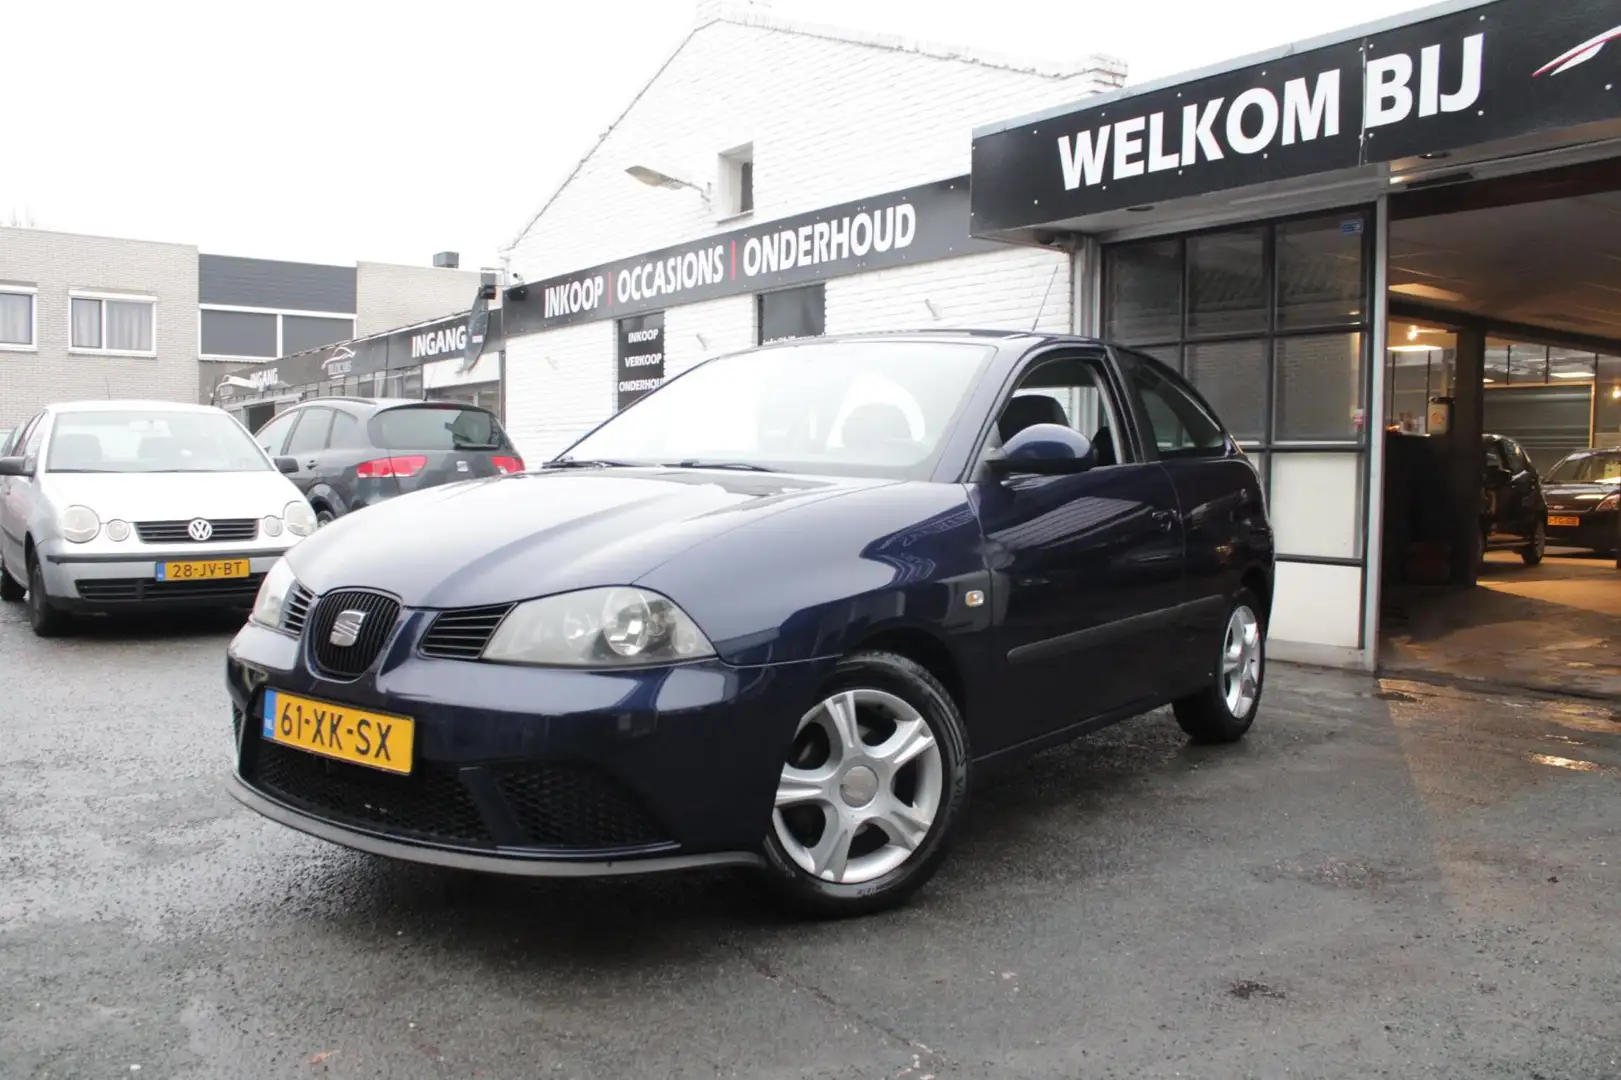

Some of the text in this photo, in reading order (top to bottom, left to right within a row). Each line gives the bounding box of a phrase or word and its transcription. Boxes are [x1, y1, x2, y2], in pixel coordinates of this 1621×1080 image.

[1057, 33, 1485, 191] WELKOM BIJ
[544, 203, 917, 318] INKOOP OCCASIONS ONDERHOUD
[411, 325, 467, 358] INGANG
[628, 328, 659, 344] INKOOP
[624, 353, 663, 368] VERKOOP
[172, 561, 243, 578] 28-JV-BT
[281, 702, 393, 762] 61-XK-SX
